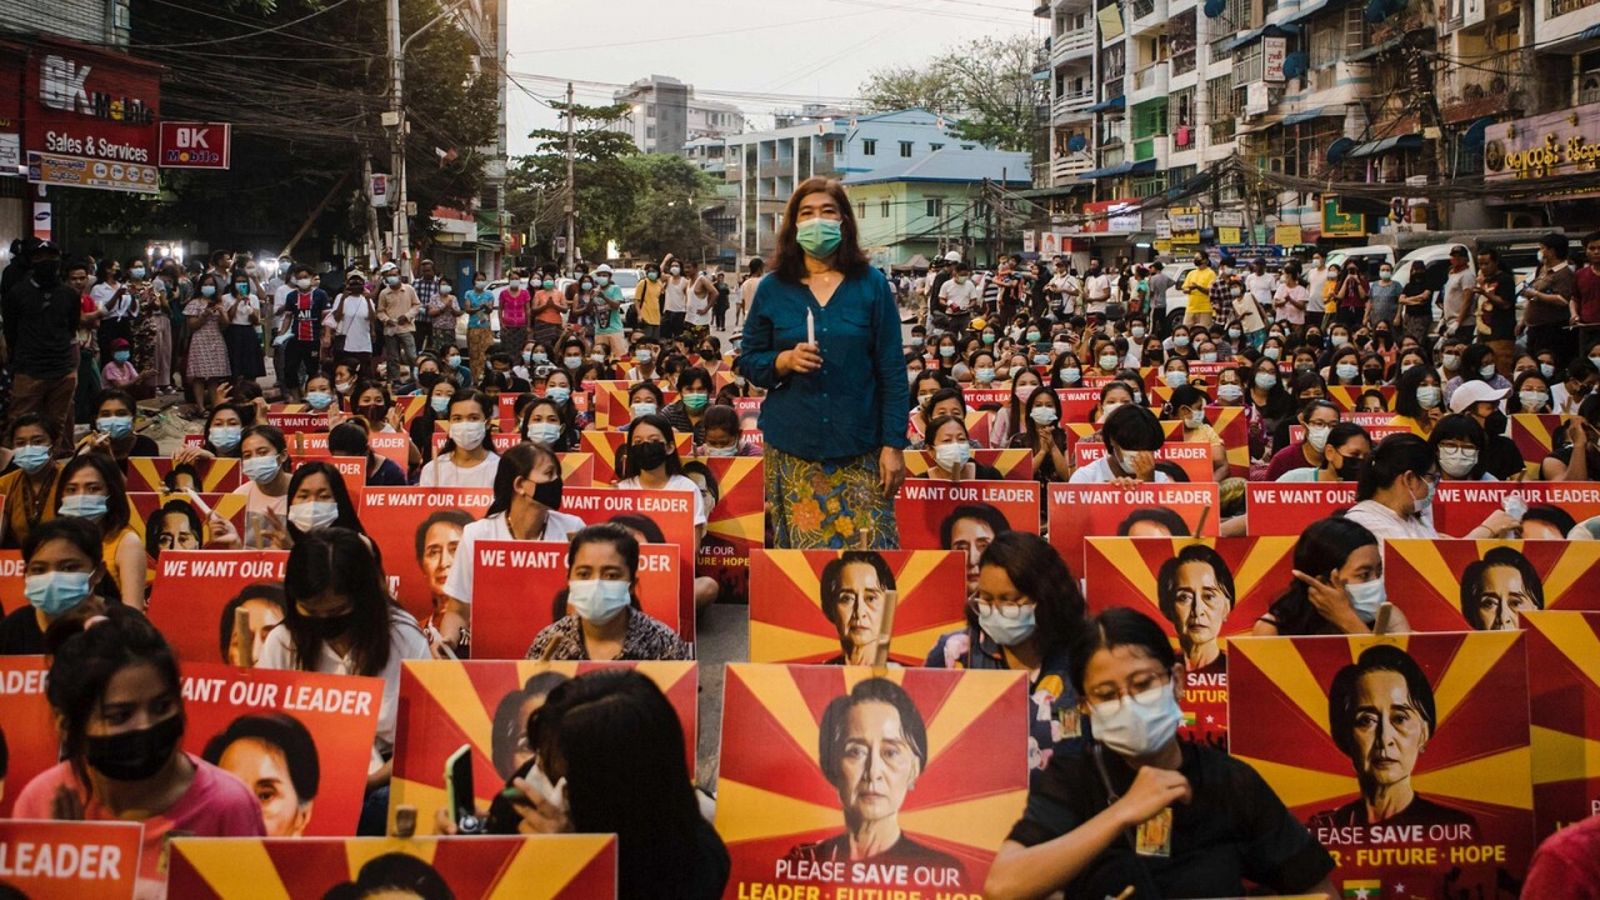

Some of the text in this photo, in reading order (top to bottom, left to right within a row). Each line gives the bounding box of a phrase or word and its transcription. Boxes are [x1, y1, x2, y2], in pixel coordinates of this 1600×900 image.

[46, 131, 148, 163] Sales & Services
[167, 149, 219, 162] Mobile
[976, 394, 993, 402] OUR
[1067, 392, 1090, 400] WANT
[739, 401, 756, 409] OUR
[269, 418, 282, 427] WE
[283, 418, 310, 427] WANT
[311, 439, 328, 448] WA
[372, 438, 404, 447] EADER
[1081, 449, 1098, 460] WE
[1164, 448, 1207, 459] LEADER
[366, 494, 385, 506] WE
[388, 494, 424, 507] WANT
[427, 494, 454, 507] OUR
[905, 487, 946, 500] WANT
[949, 488, 978, 501] OUR
[982, 489, 1034, 502] LEADER
[1054, 491, 1212, 504] WE WANT OUR LEADER
[1253, 490, 1275, 503] WE
[1279, 490, 1322, 503] WANT
[1438, 489, 1461, 502] WE
[1464, 489, 1507, 502] WANT
[1545, 489, 1600, 503] LEADER
[561, 495, 688, 512] WANT OUR LEADER
[713, 546, 735, 555] OUR
[480, 550, 505, 567] WE
[510, 551, 560, 569] WANT
[723, 558, 749, 566] HOPE
[164, 560, 187, 577] WE
[191, 561, 236, 577] WANT
[240, 562, 273, 578] OUR
[1186, 673, 1227, 686] SAVE
[181, 676, 372, 717] ANT OUR LEADER
[1317, 823, 1473, 845] EASE SAVE OUR
[0, 842, 121, 881] LEADER
[1356, 847, 1438, 866] FUTURE
[1450, 844, 1506, 864] HOPE
[775, 859, 961, 887] PLEASE SAVE OUR
[737, 882, 821, 900] LEADER
